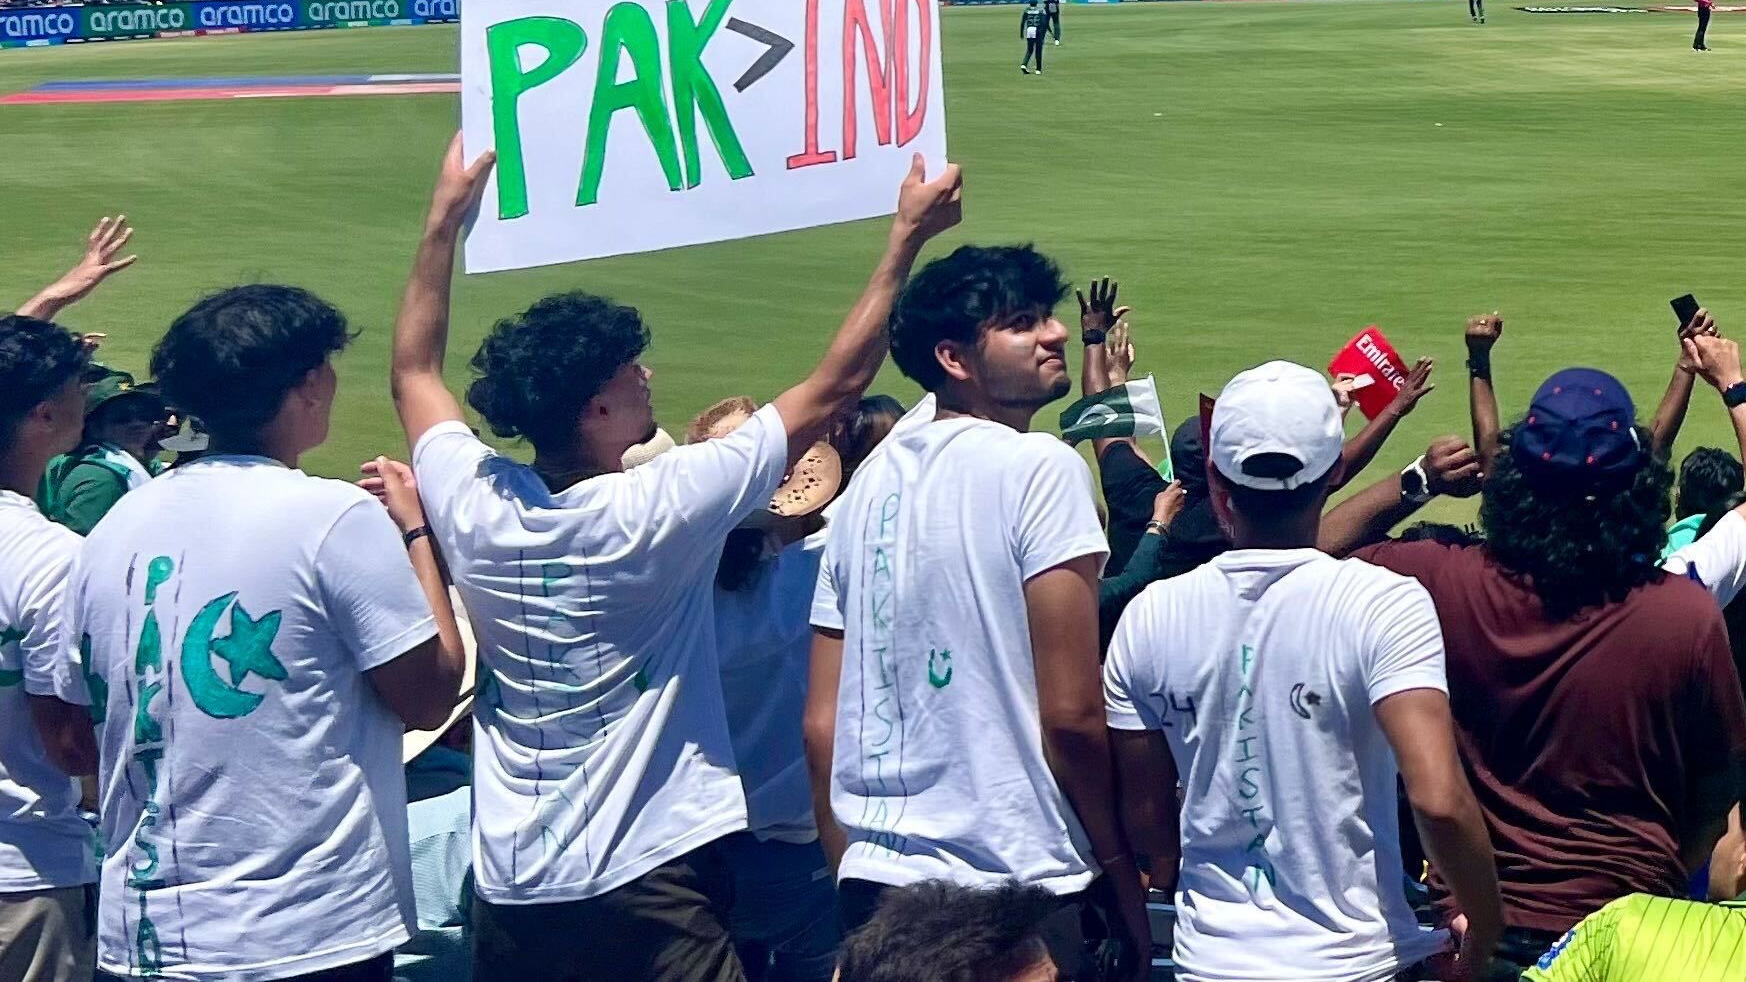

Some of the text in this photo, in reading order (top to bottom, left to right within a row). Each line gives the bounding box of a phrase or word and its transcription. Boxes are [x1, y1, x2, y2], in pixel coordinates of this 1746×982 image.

[90, 9, 185, 32] aramco
[200, 4, 294, 28] aramco
[309, 0, 400, 22] aramco
[866, 491, 902, 859] PAKISTAN
[1148, 690, 1199, 728] 24
